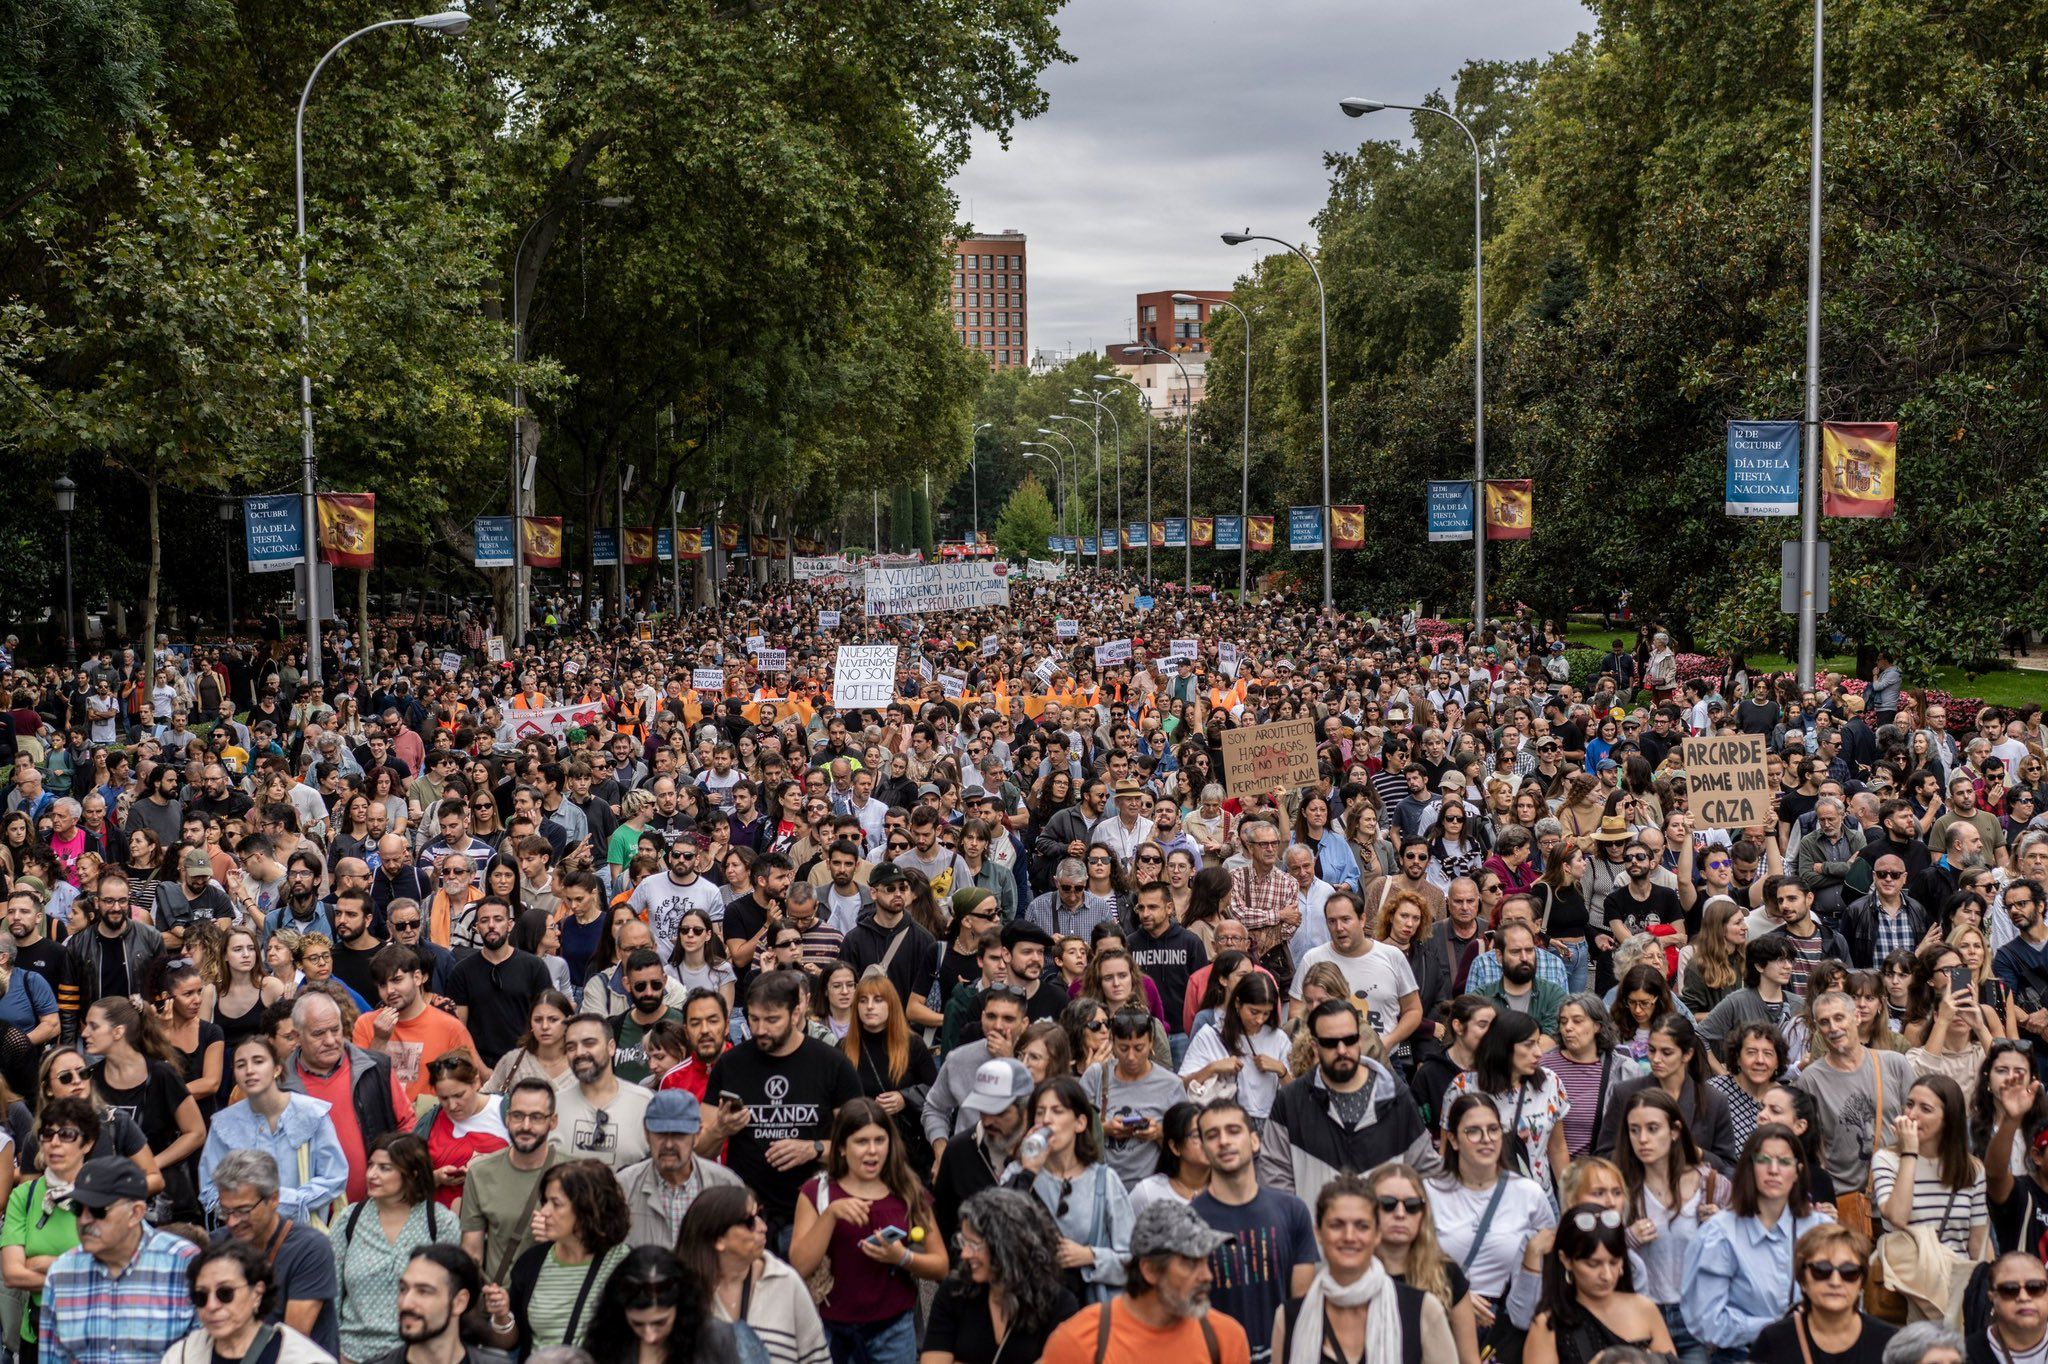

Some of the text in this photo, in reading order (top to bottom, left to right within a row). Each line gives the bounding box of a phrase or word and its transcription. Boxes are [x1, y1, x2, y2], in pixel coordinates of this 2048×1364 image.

[1734, 441, 1781, 449] OCTUBRE
[1734, 458, 1789, 468] DÍA DE LA
[1734, 472, 1772, 480] FIESTA
[1733, 485, 1794, 494] NACIONAL
[252, 524, 267, 533] DÍA
[253, 535, 283, 543] FIESTA
[253, 544, 300, 554] NACIONAL
[867, 563, 989, 585] LA VIVIENDA SOCIAL
[867, 579, 1006, 600] PARA EMERGENCIA HABITACIONAL
[890, 600, 913, 613] PARA
[841, 647, 896, 657] NUESTRAS
[839, 658, 895, 667] VIVIENDAS
[839, 668, 891, 680] NO SON
[836, 685, 892, 700] HOTELES
[1228, 733, 1246, 744] SOY
[1239, 739, 1307, 760] HAGO CASAS,
[1687, 740, 1761, 766] ARCARDE
[1232, 753, 1309, 775] PERO NO PUEDO
[1233, 768, 1316, 793] PERMITIRME UNA
[1690, 768, 1766, 792] DAME UNA
[1702, 798, 1754, 823] CAZA
[1132, 949, 1187, 965] UNENDING
[770, 1080, 782, 1094] K
[754, 1129, 799, 1139] DANIELO
